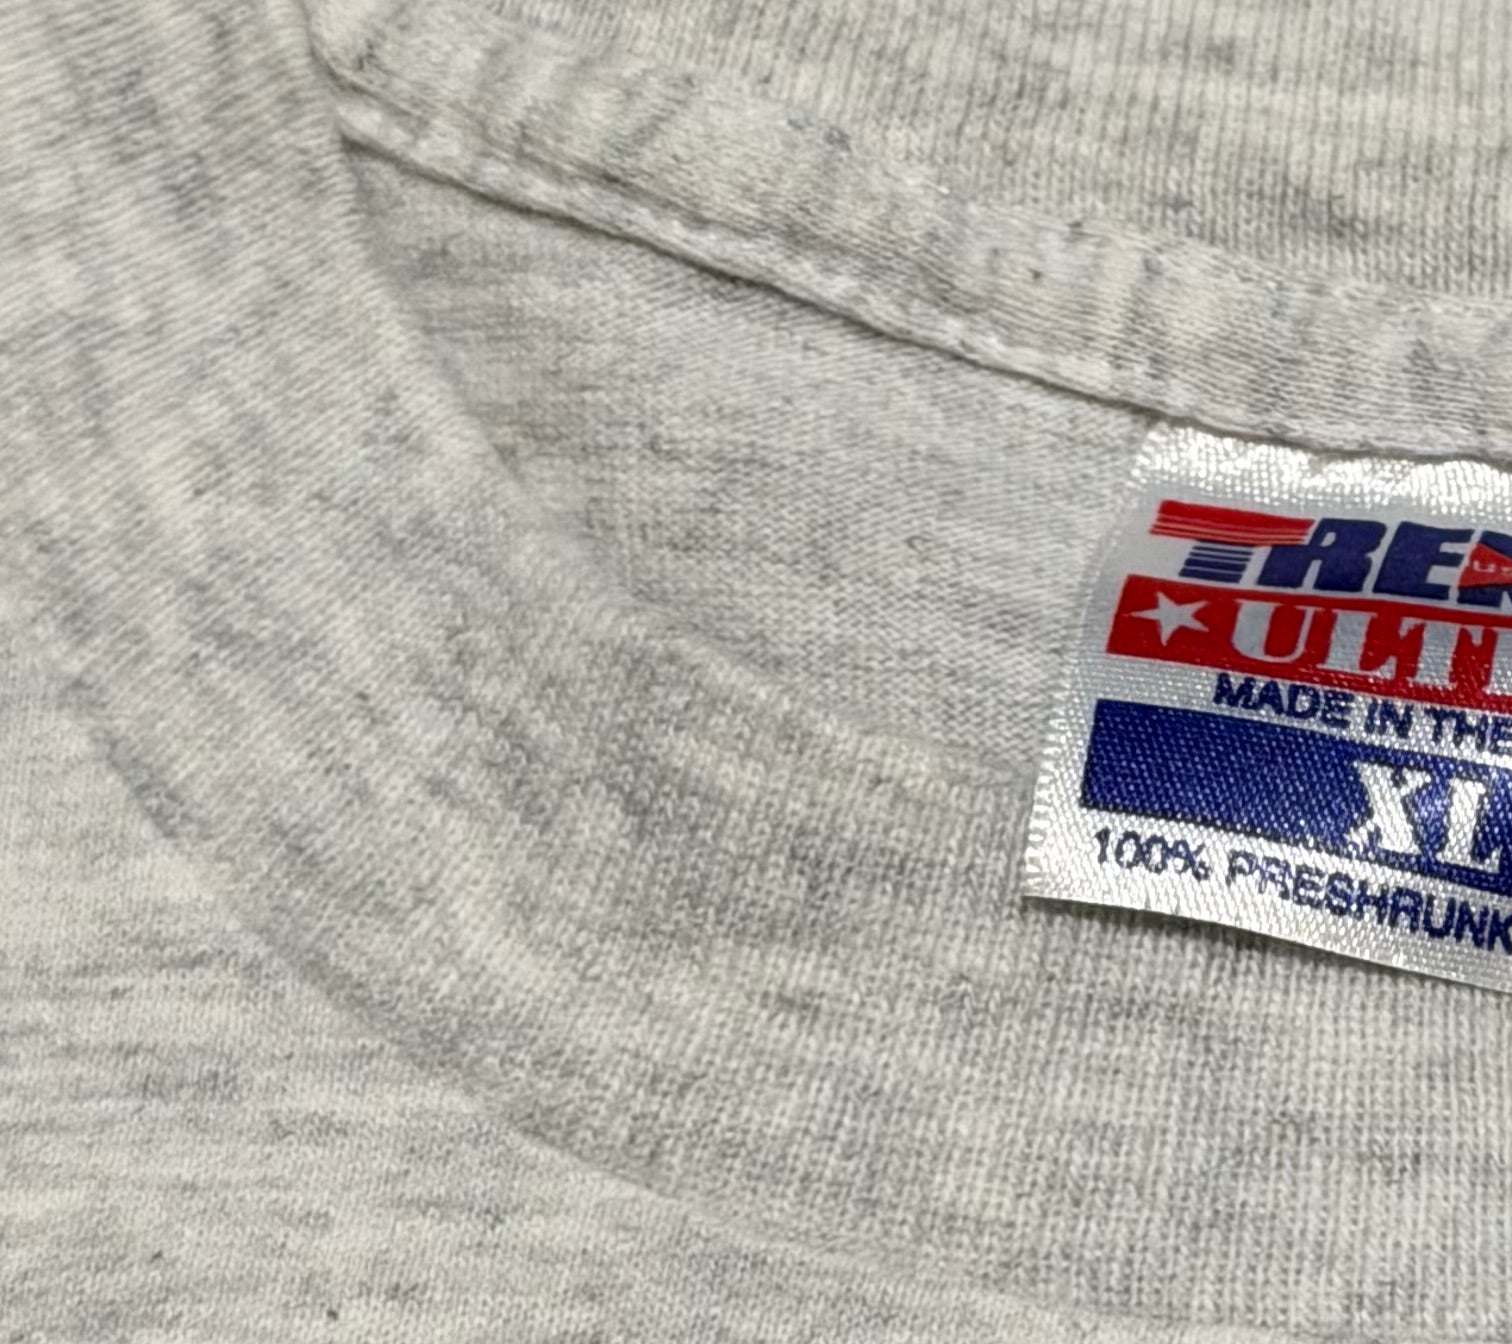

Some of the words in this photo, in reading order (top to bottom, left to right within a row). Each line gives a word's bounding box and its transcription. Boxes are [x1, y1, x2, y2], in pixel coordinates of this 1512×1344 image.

[1213, 672, 1354, 729] MADE
[1363, 697, 1414, 739] IN
[1343, 757, 1502, 874] XL
[1095, 826, 1211, 882] 100%
